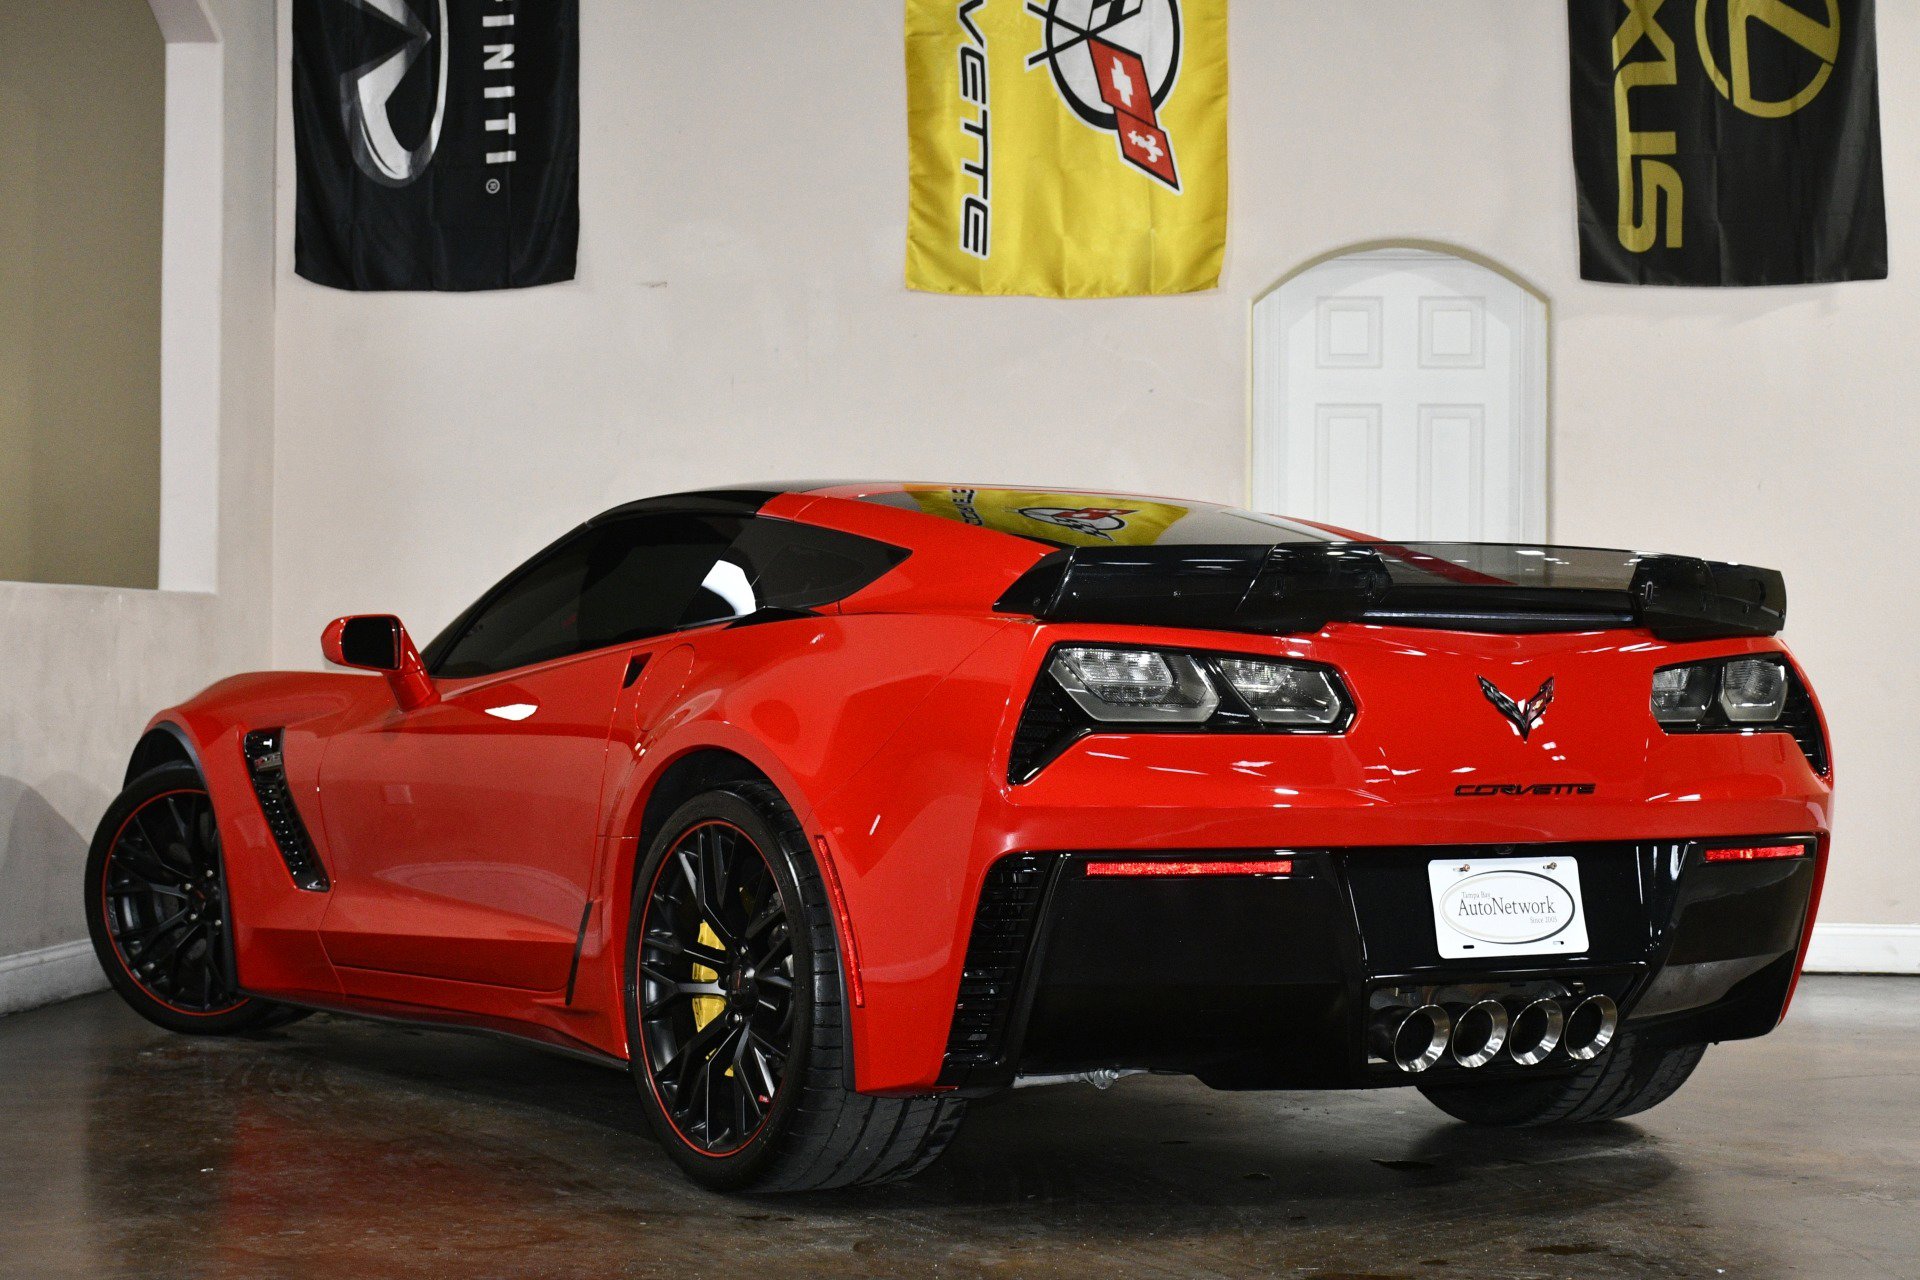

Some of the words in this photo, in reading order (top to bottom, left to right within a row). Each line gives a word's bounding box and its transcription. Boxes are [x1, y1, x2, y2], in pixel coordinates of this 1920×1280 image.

[482, 0, 516, 164] INITI
[1454, 783, 1597, 797] CORVETTE
[1458, 895, 1556, 917] AutoNetwork
